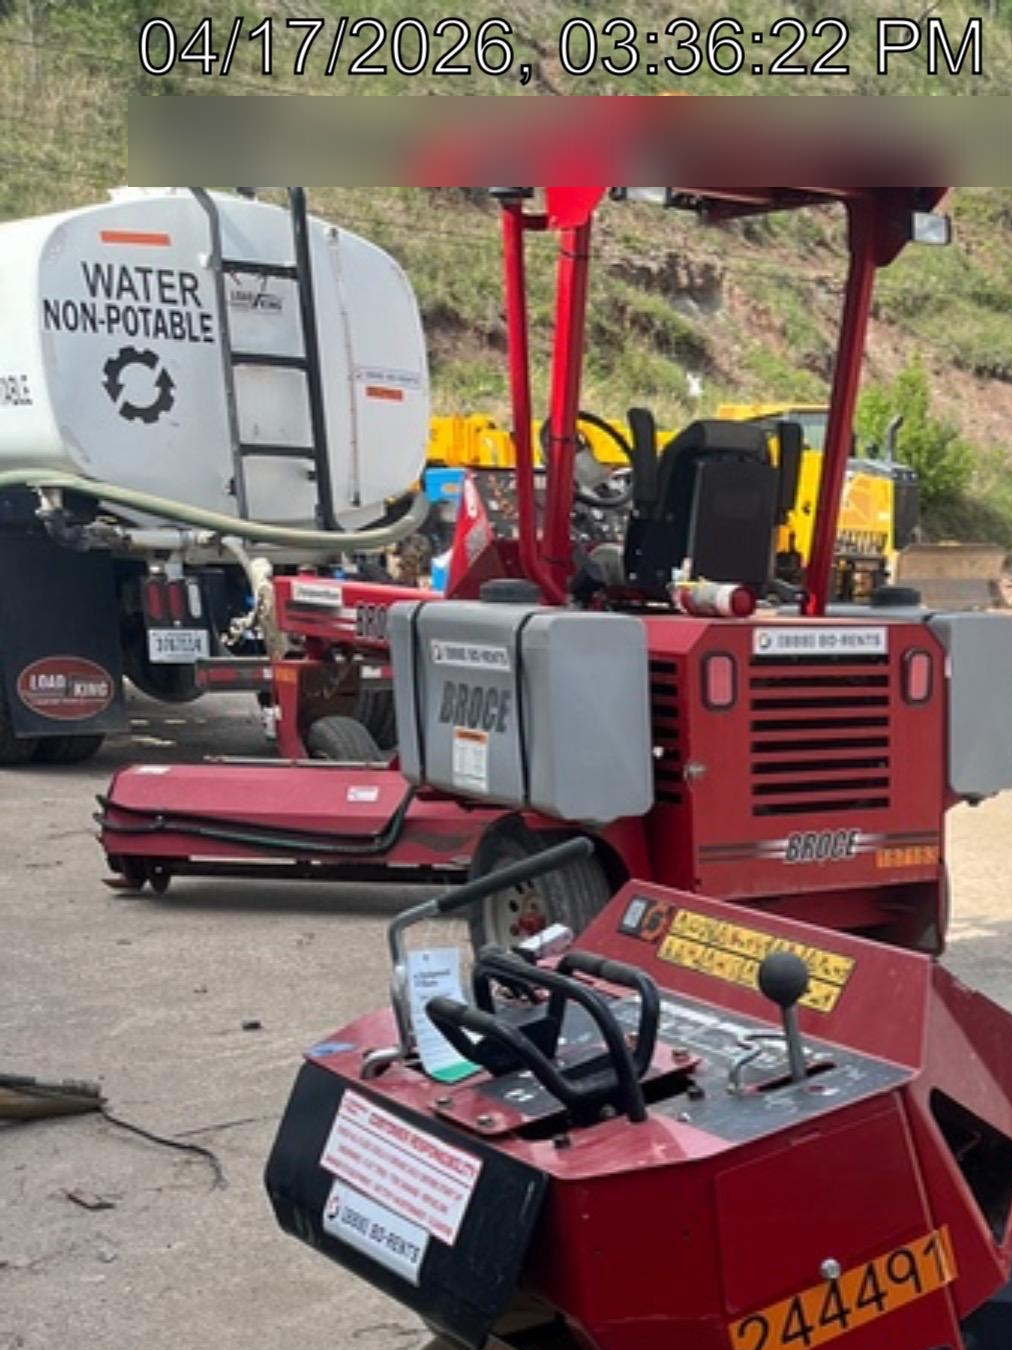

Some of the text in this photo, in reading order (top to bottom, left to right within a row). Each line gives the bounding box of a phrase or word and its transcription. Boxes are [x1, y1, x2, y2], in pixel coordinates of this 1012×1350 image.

[81, 261, 203, 308] WATER
[43, 299, 215, 343] NON-POTABLE
[29, 673, 109, 697] LOAD KING
[438, 681, 513, 734] BROCE
[785, 830, 860, 862] BROCE
